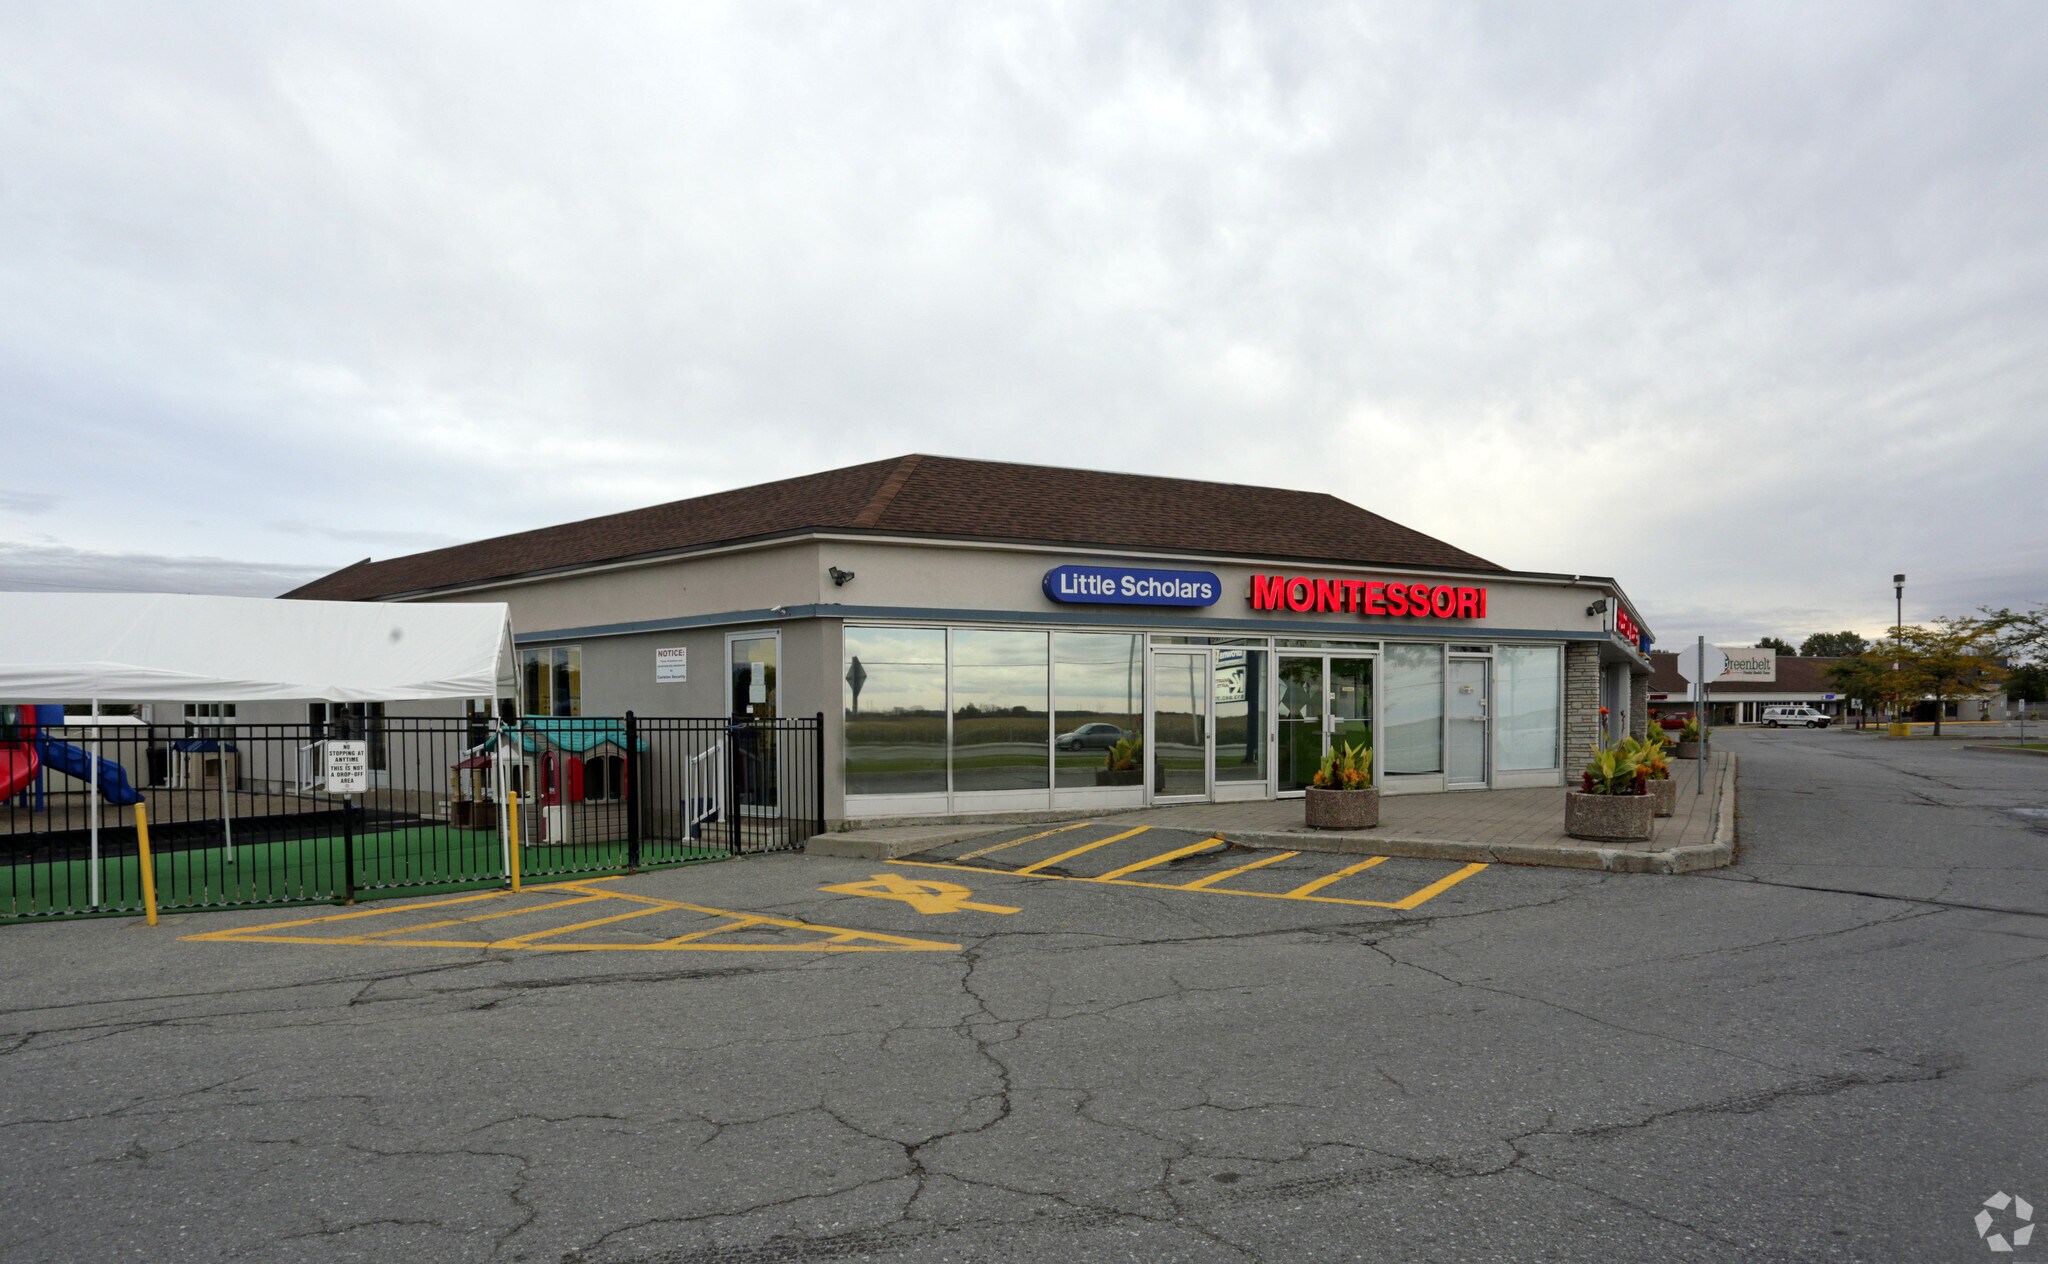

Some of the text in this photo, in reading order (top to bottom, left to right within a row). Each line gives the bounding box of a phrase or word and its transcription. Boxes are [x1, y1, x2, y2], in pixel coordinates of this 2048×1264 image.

[1060, 573, 1212, 599] Little Scholars
[1251, 574, 1487, 618] MONTESSORI
[658, 649, 685, 657] NOTICE:
